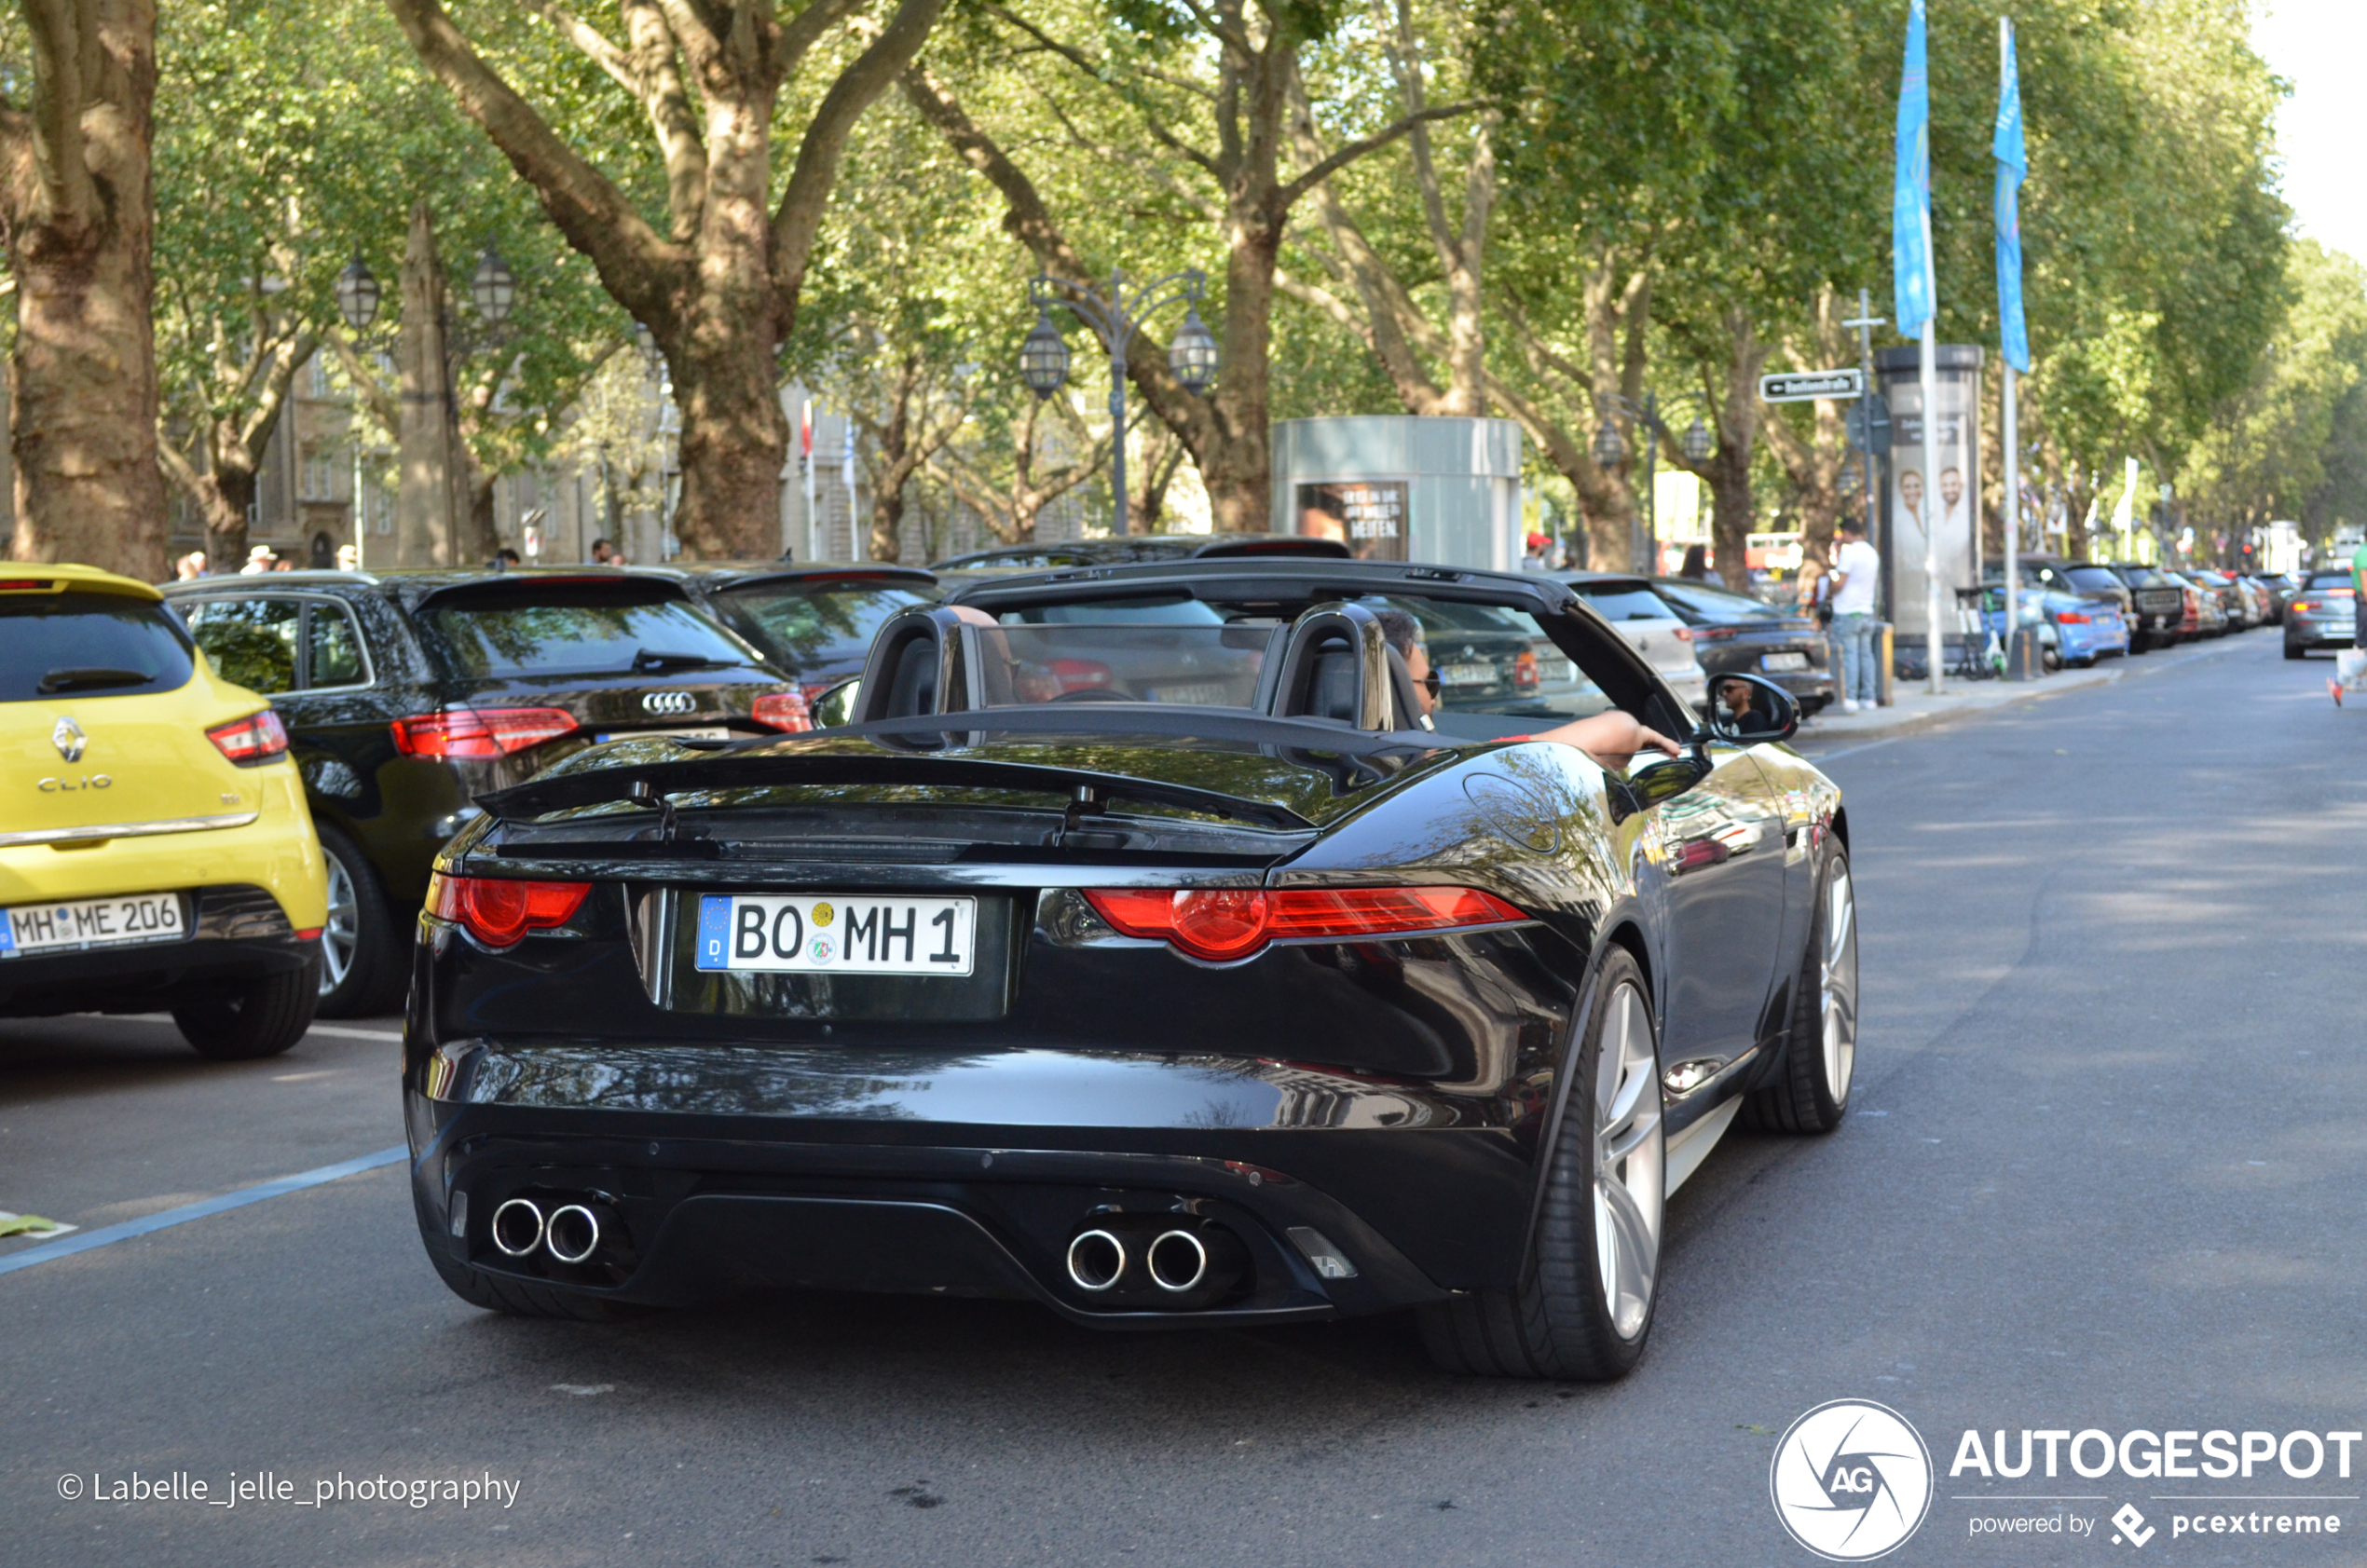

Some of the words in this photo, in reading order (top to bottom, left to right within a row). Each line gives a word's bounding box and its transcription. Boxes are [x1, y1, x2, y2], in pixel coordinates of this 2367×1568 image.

[37, 773, 112, 791] CLIO
[11, 909, 56, 943] MH
[74, 904, 116, 936] ME
[121, 898, 176, 931] 206
[709, 939, 720, 956] D
[735, 905, 803, 960] BO
[843, 906, 916, 961] MH
[930, 907, 960, 962] 1
